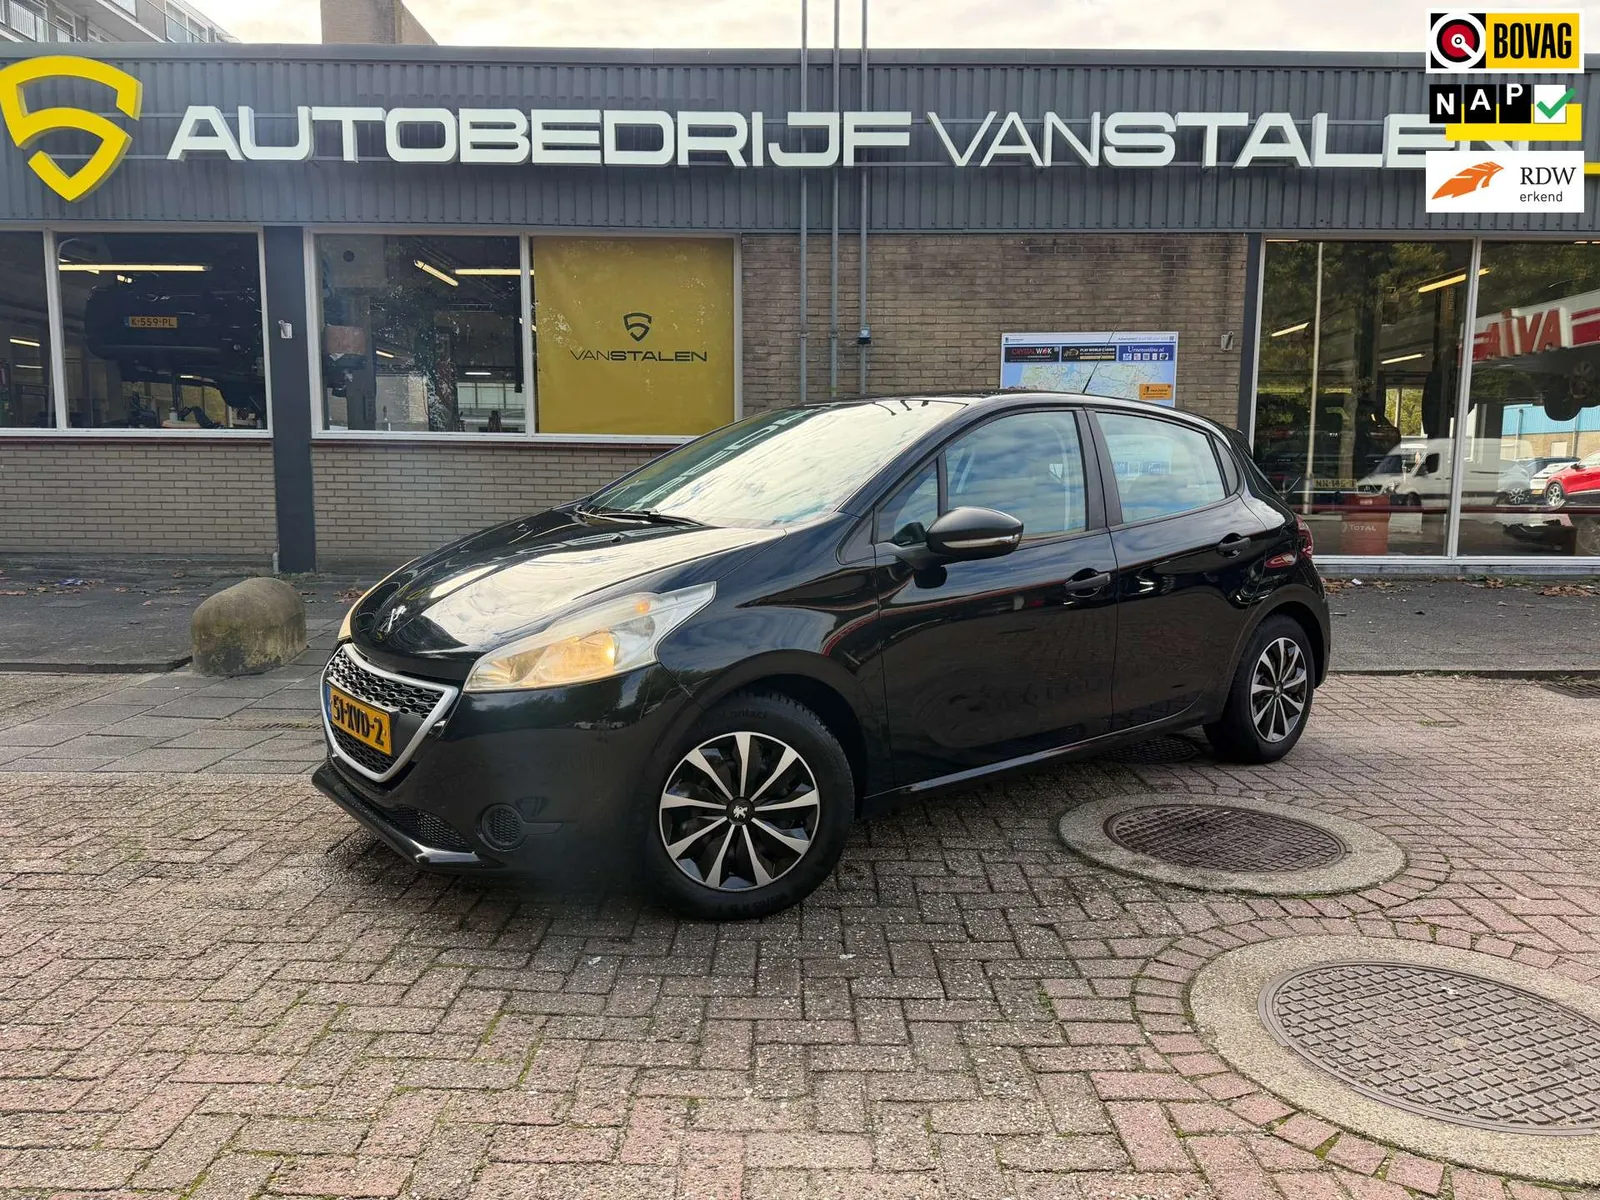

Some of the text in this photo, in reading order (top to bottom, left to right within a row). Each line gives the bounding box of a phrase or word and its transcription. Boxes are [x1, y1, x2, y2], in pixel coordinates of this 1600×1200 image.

[166, 105, 1530, 169] AUTOBEDRIJF VANSTALE
[569, 349, 708, 362] VANSTALEN
